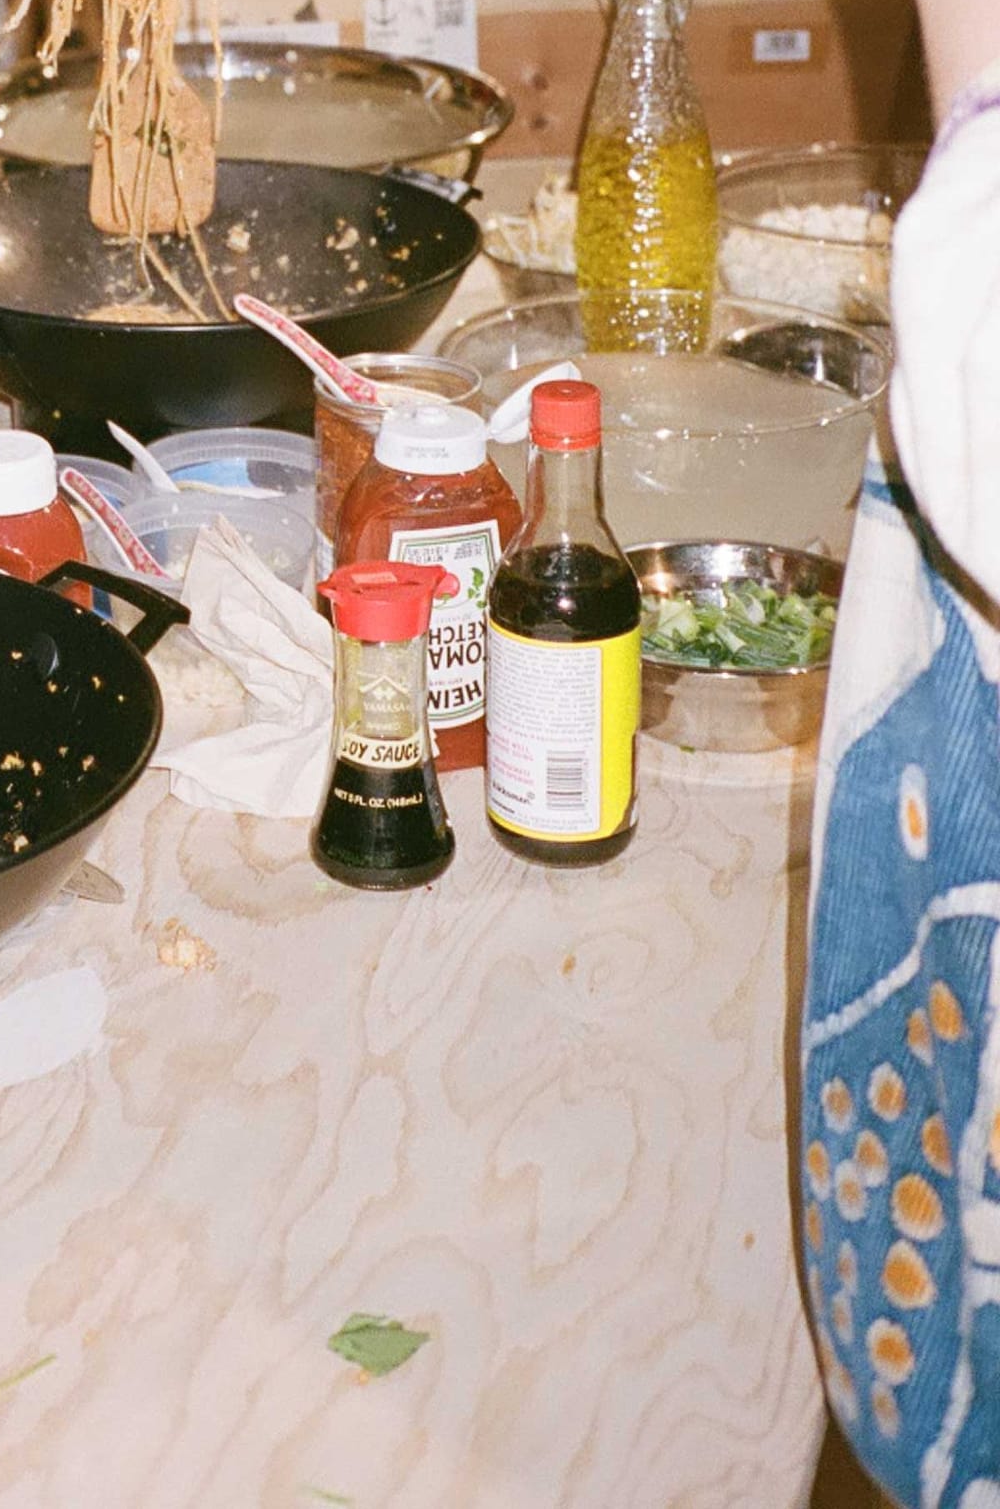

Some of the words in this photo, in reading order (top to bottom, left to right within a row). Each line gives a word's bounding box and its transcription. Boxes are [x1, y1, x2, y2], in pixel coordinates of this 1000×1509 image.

[428, 621, 487, 645] KETCH
[428, 641, 483, 670] OMA
[427, 680, 482, 710] HEIN
[371, 739, 420, 763] SAUCE
